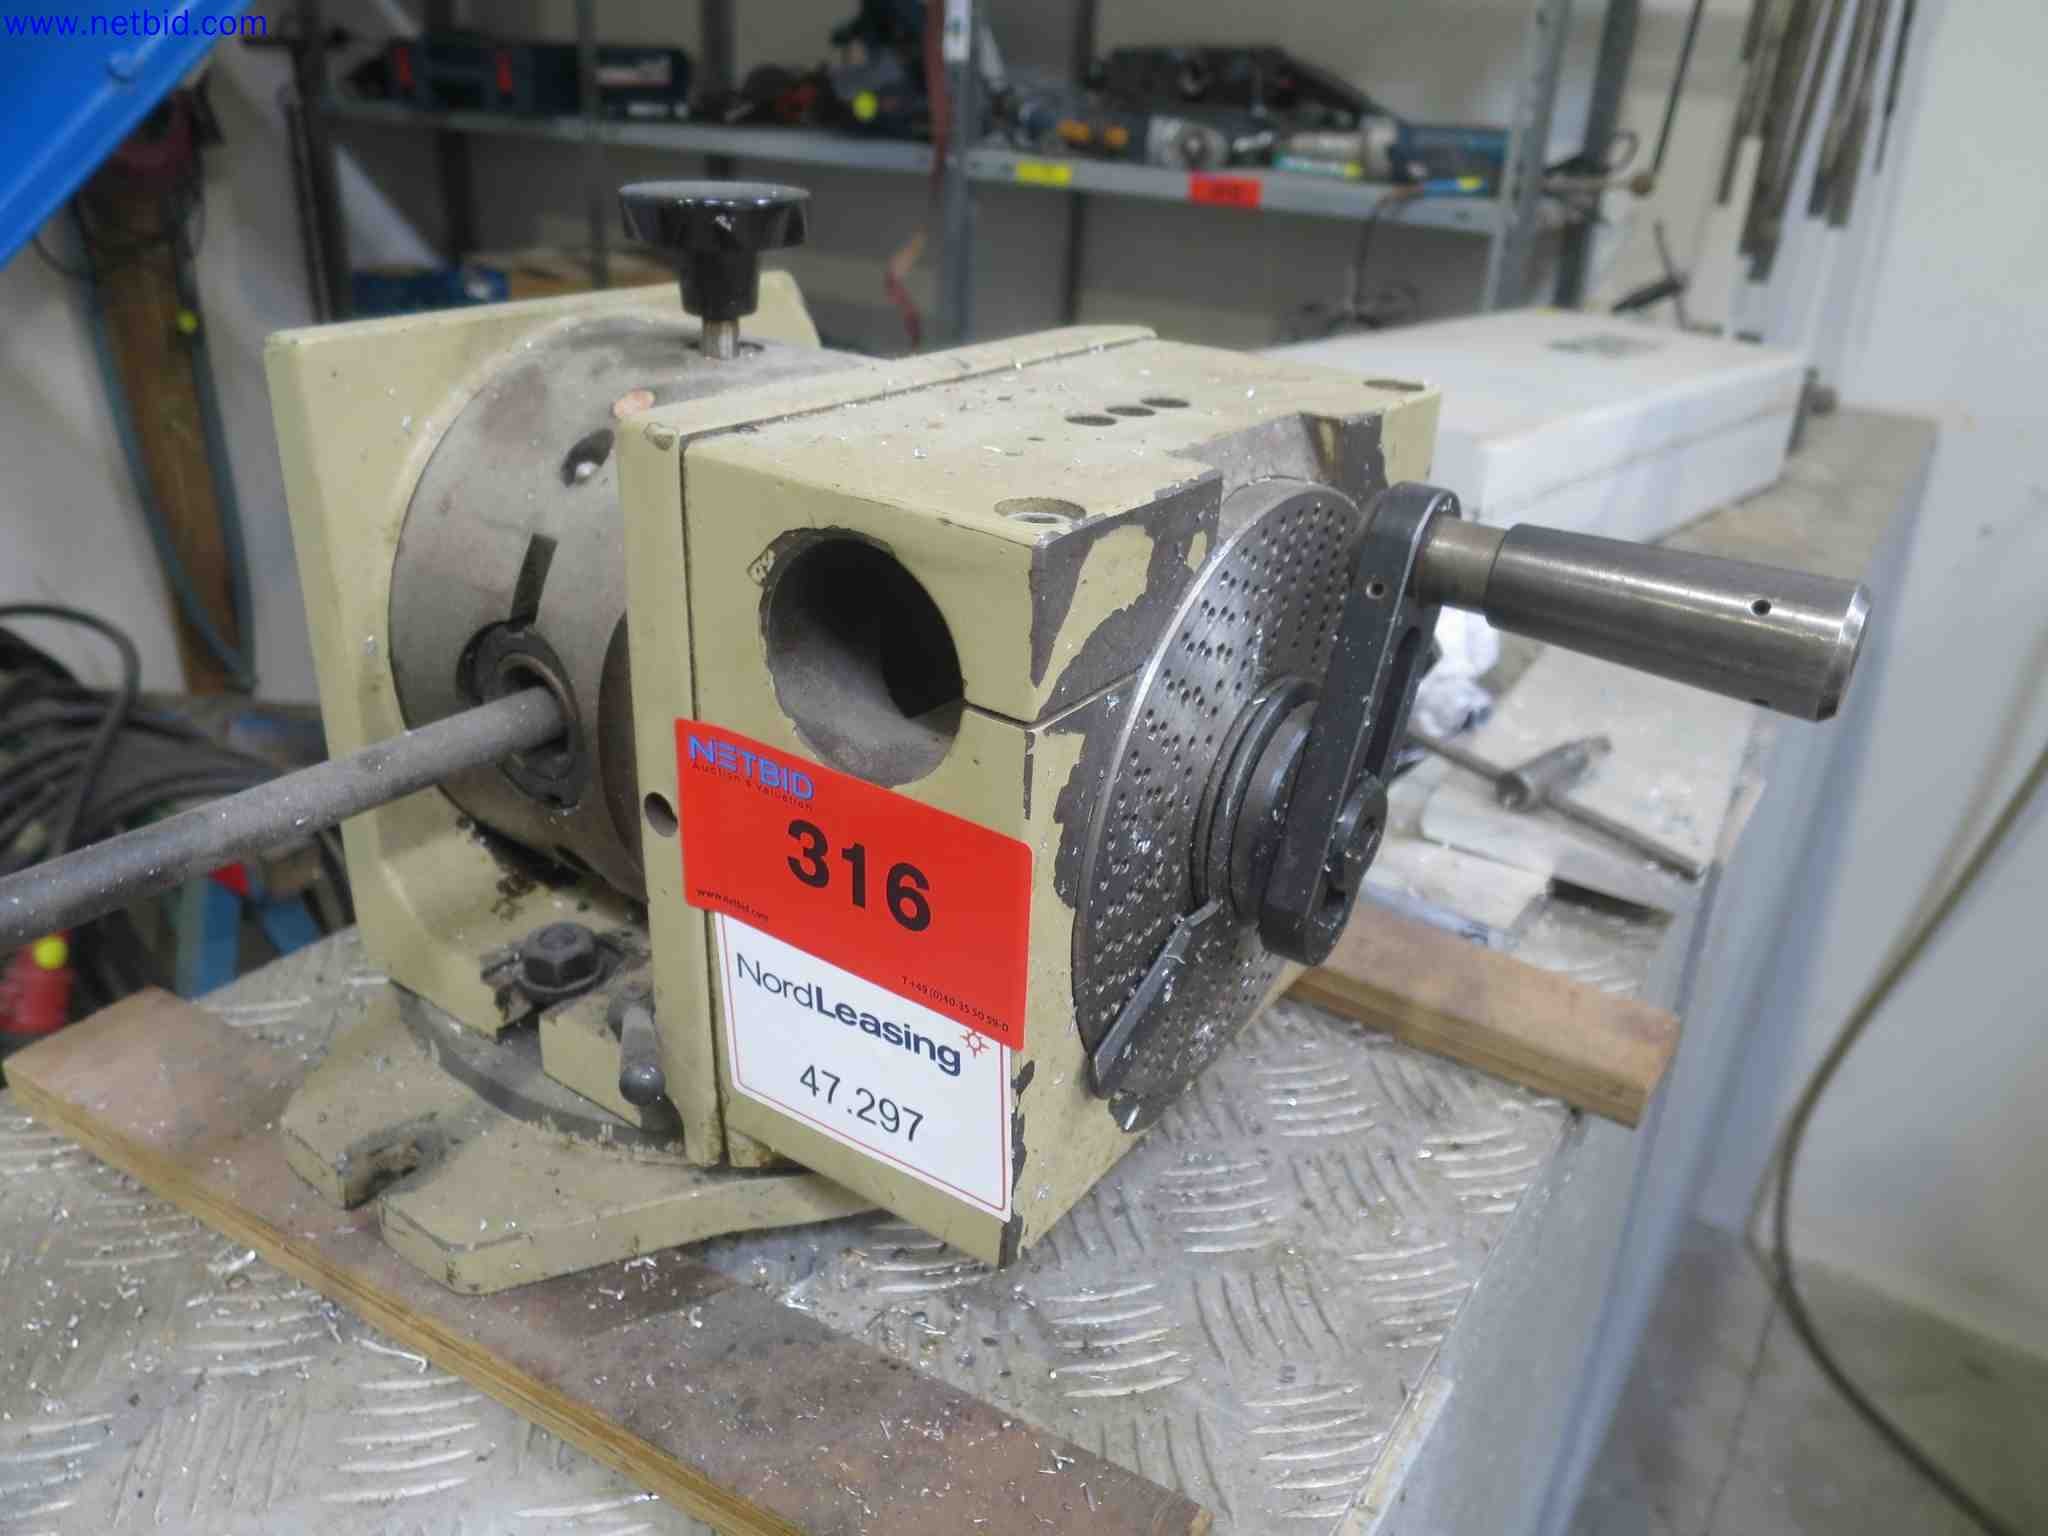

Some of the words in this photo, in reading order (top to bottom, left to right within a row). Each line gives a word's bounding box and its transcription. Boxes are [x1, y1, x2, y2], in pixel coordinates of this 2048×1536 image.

[689, 736, 815, 801] NETBID
[787, 818, 932, 932] 316
[736, 952, 962, 1077] NordLeasing
[799, 1064, 925, 1142] 47.297
